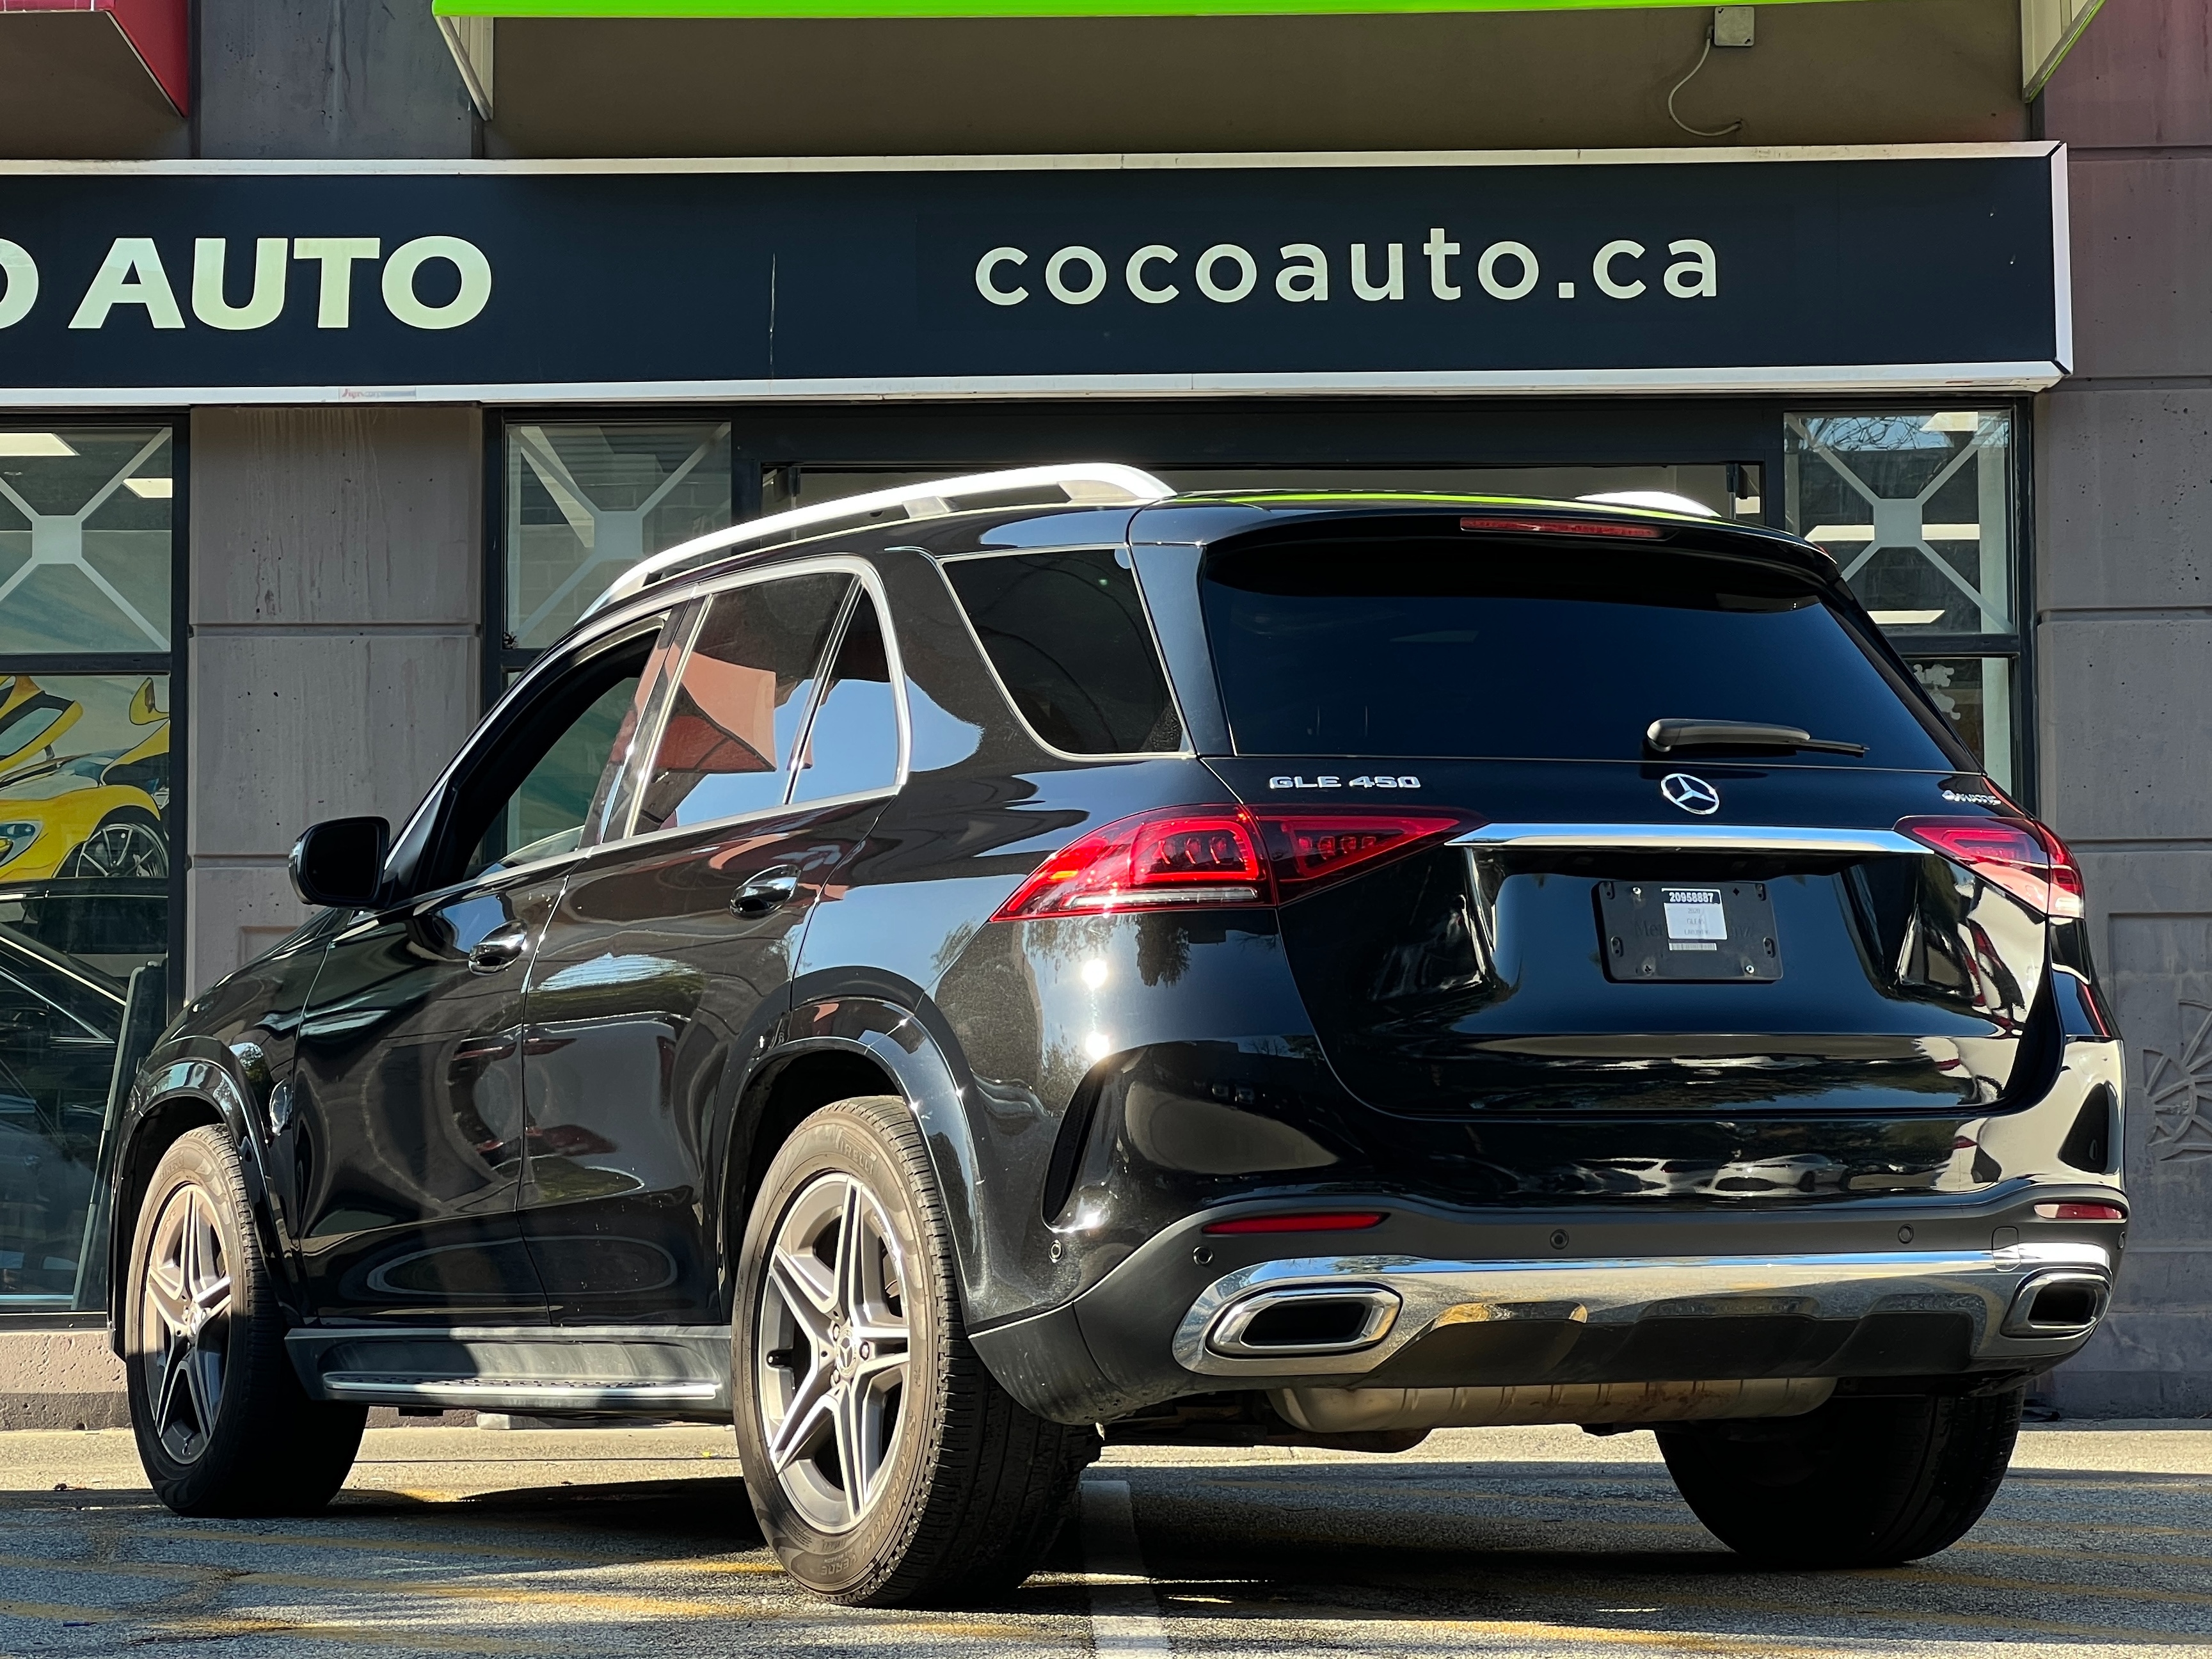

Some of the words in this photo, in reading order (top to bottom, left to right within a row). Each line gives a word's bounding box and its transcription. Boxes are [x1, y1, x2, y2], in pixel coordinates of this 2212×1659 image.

[67, 235, 492, 331] AUTO
[975, 227, 1717, 305] cocoauto.ca
[1269, 776, 1342, 789] GLE
[1348, 776, 1421, 788] 450
